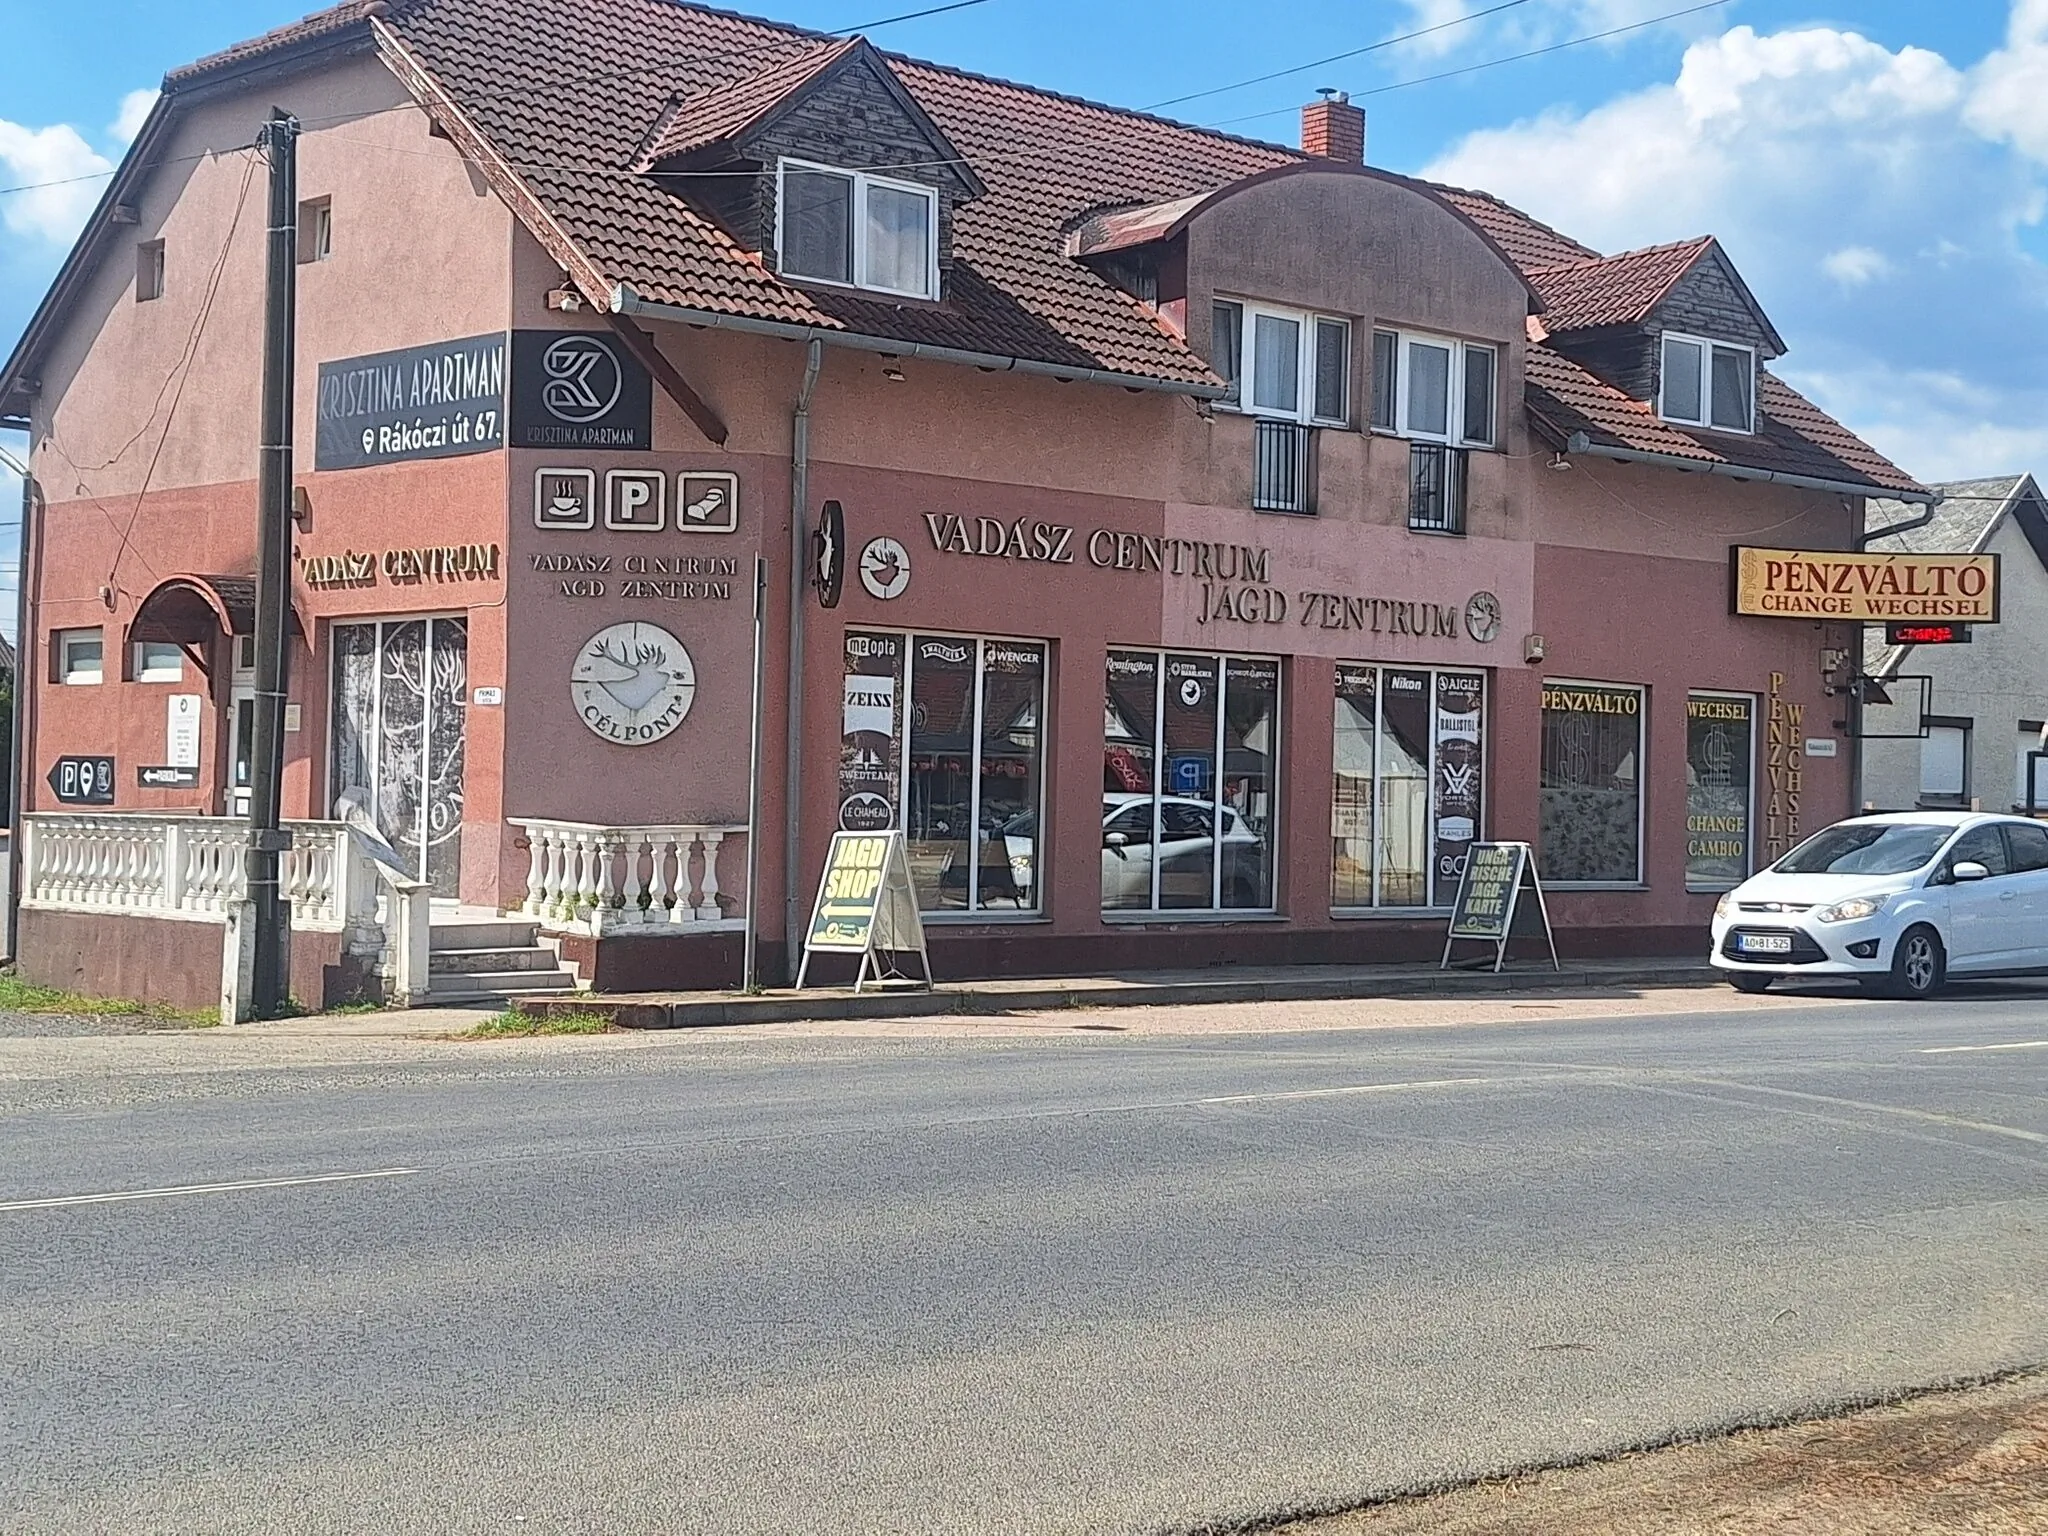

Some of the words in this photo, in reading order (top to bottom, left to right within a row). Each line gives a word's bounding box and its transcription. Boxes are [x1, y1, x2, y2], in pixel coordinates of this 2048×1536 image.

[319, 363, 403, 421] KRISZTINA
[409, 346, 503, 408] APARTMAN
[379, 417, 447, 454] Rákóczi
[451, 412, 469, 444] út
[474, 411, 501, 442] 67.
[527, 426, 578, 443] KRISZTINA
[581, 428, 634, 445] APARTMAN
[922, 512, 1075, 564] VADÁSZ
[1088, 528, 1272, 584] CENTRUM
[381, 544, 497, 579] CENTRUM
[1764, 552, 1987, 597] PÉNZVÁLTÓ
[620, 580, 731, 599] ZENTRUM
[1197, 583, 1287, 625] JAGD
[1300, 591, 1459, 638] ZENTRUM
[1762, 594, 1852, 614] CHANGE
[1865, 599, 1989, 616] WECHSEL
[850, 637, 896, 658] meopta
[927, 645, 960, 660] WALTHER
[996, 651, 1039, 664] WENGER
[1106, 657, 1154, 674] Remington
[1391, 675, 1422, 690] Nikon
[1449, 678, 1480, 691] AIGLE
[847, 692, 892, 708] ZEISS
[1541, 686, 1638, 715] PÉNZVÁLTÓ
[1687, 702, 1749, 720] WECHSEL
[584, 703, 682, 741] CÉLPONT
[1440, 718, 1476, 732] BALLISTOL
[840, 770, 893, 781] SWEDTEAM
[844, 806, 853, 818] LE
[853, 806, 888, 818] CHAMEAU
[1687, 815, 1745, 833] CHANGE
[834, 838, 886, 867] JAGD
[1476, 849, 1513, 865] UNGA-
[1688, 840, 1743, 857] CAMBIO
[1469, 866, 1513, 881] RISCHE
[825, 868, 881, 898] SHOP
[1470, 882, 1504, 897] JAGD-
[1464, 898, 1503, 914] KARTE
